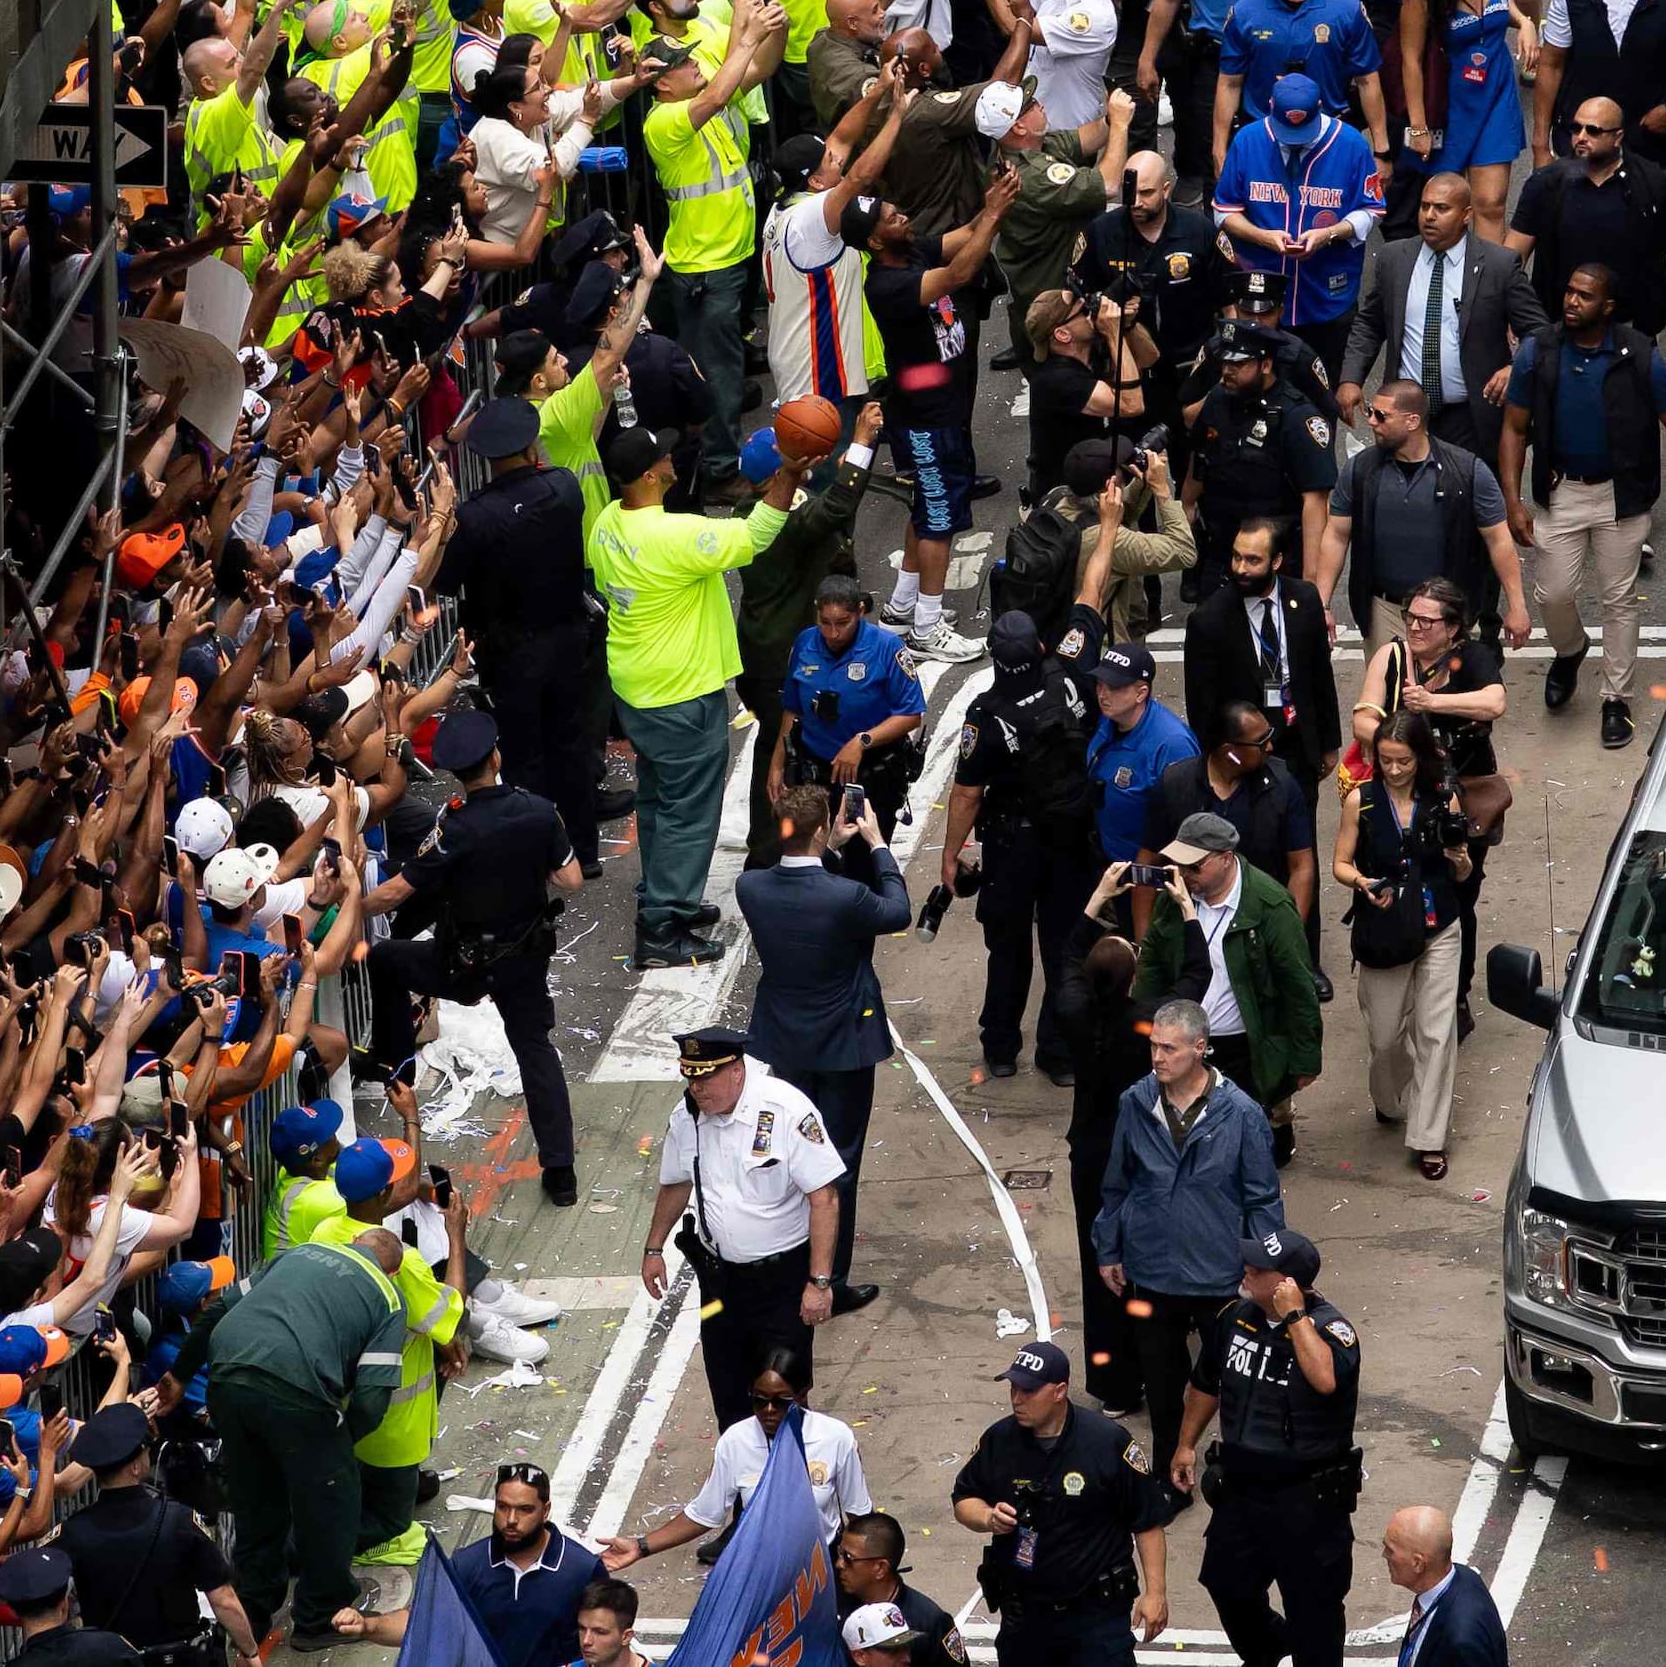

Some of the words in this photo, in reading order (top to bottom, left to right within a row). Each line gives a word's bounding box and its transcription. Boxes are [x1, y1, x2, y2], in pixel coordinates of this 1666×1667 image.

[1248, 180, 1289, 207] NEW
[1298, 184, 1344, 208] YORK
[1263, 1231, 1283, 1257] PD
[1226, 1334, 1289, 1387] POLI
